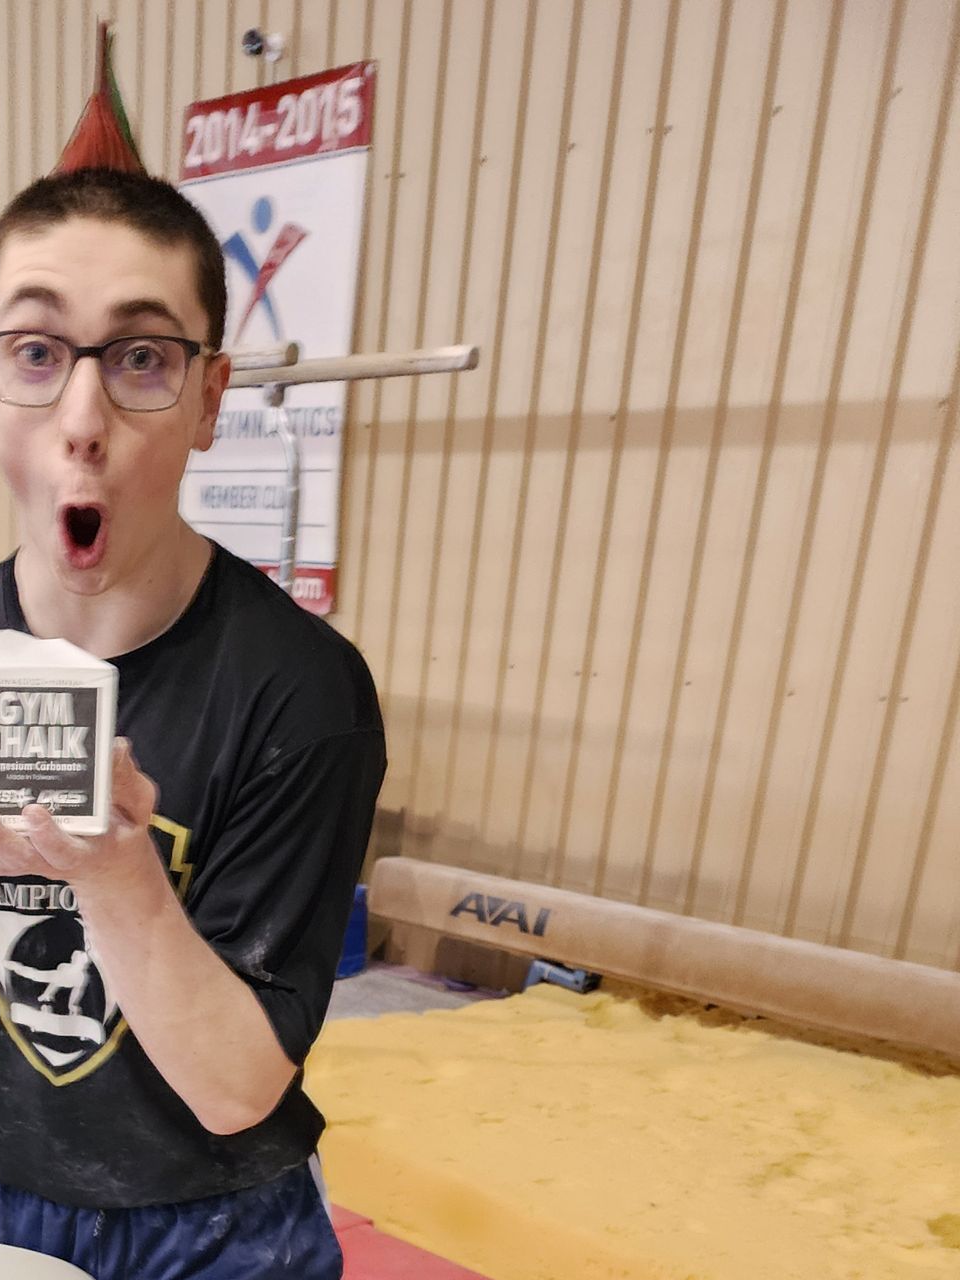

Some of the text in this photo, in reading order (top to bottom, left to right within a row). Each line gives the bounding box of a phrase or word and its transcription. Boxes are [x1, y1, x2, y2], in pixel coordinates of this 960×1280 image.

[184, 76, 365, 169] 2014-2015
[214, 408, 338, 440] GYMNTICS
[35, 761, 87, 772] Carbonate
